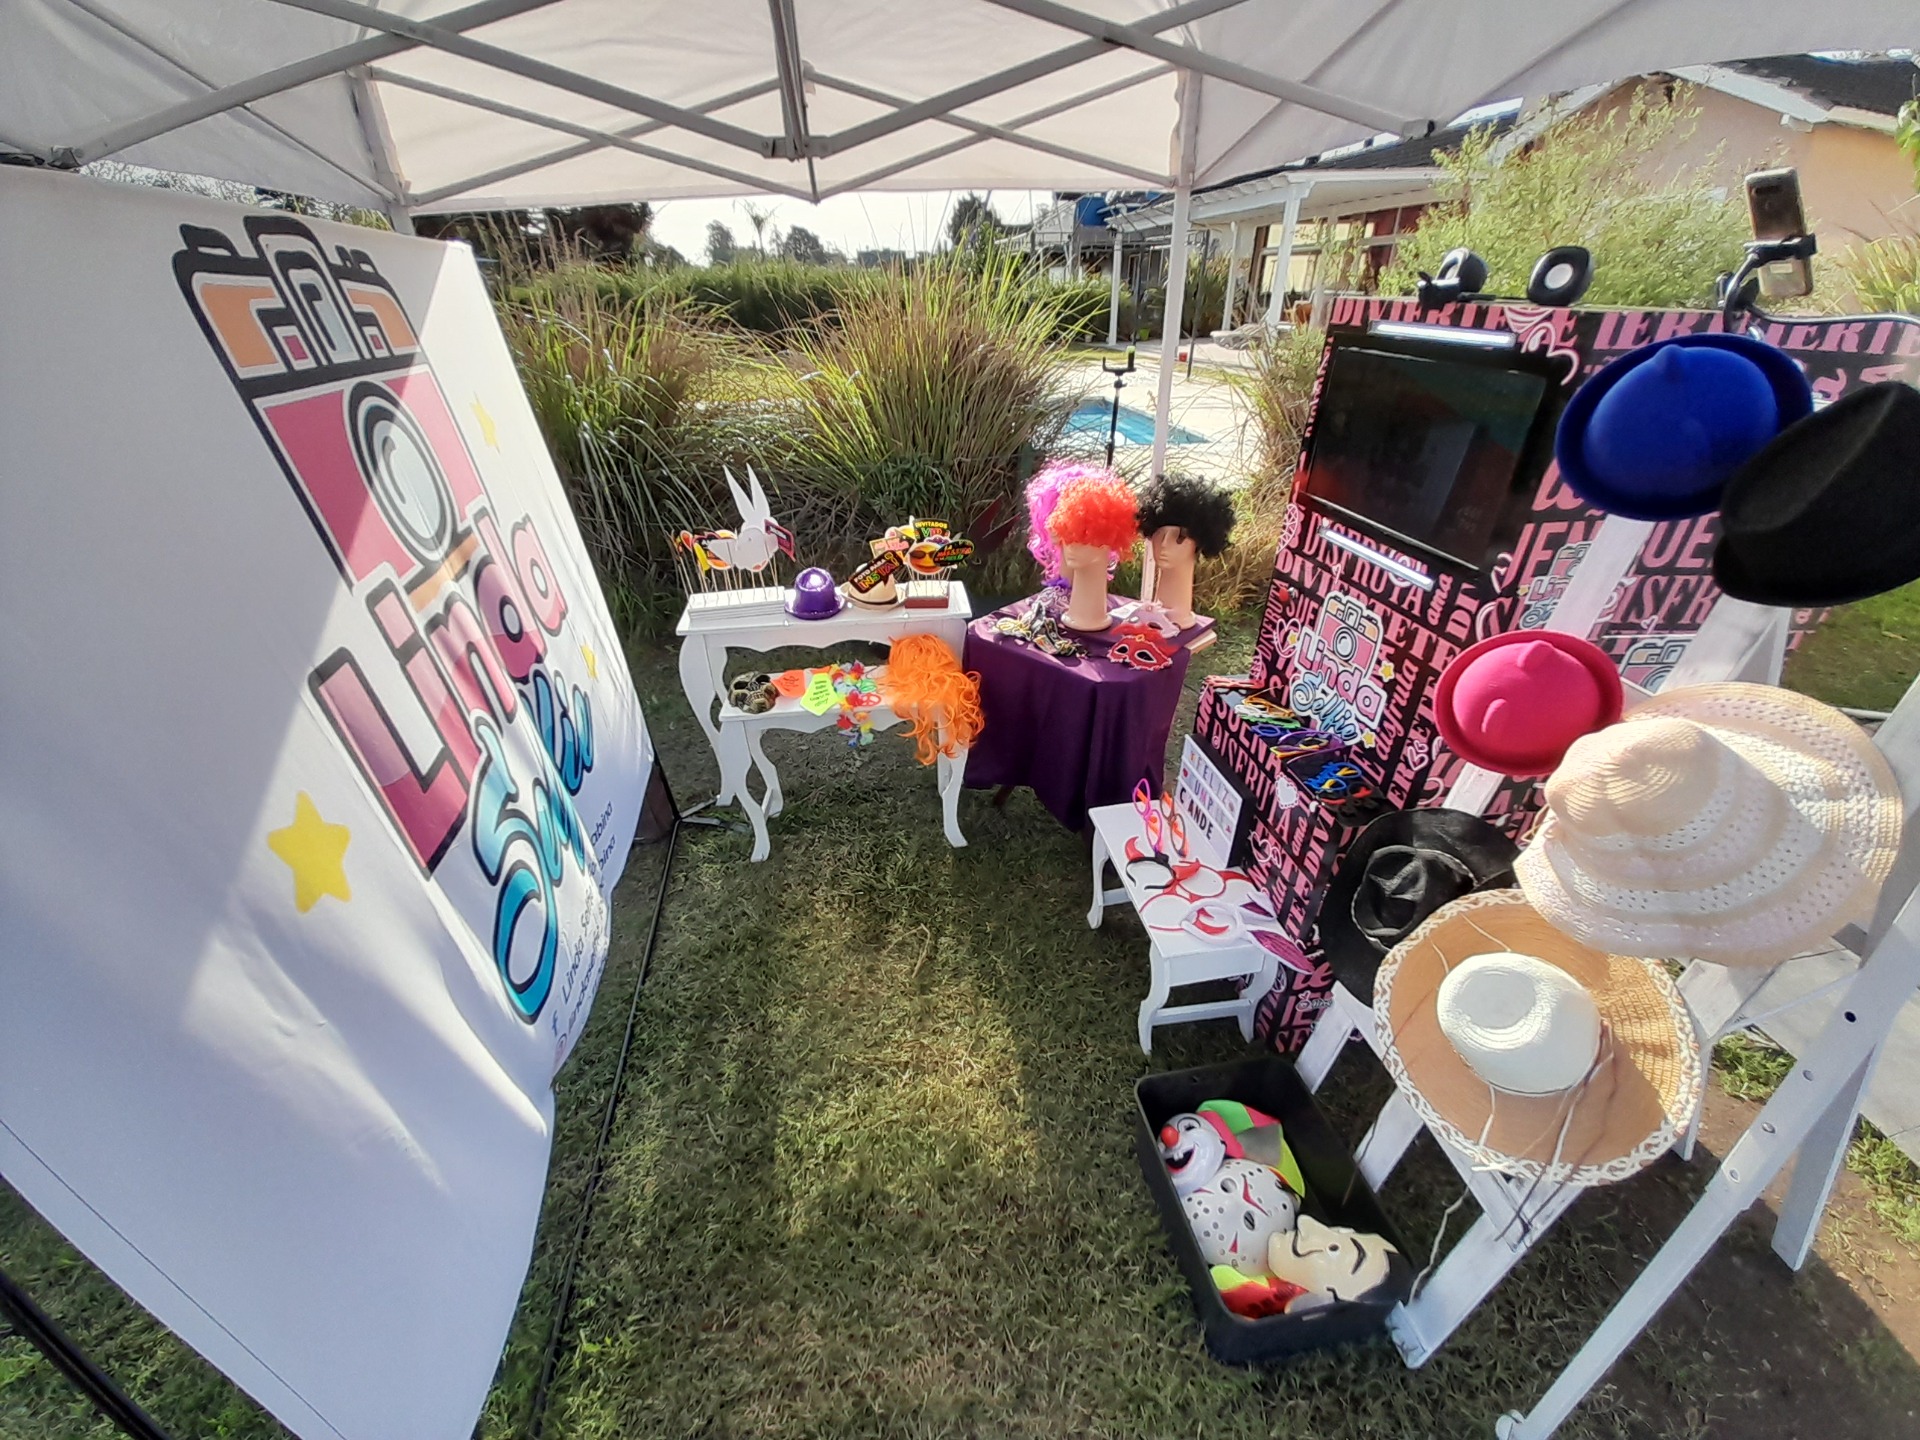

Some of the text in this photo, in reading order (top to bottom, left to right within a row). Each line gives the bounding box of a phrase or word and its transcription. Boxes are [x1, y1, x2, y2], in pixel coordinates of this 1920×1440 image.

[308, 505, 567, 880] Linda
[1293, 670, 1360, 742] Selfie
[1297, 632, 1382, 722] Linda
[1376, 658, 1419, 761] disfruta
[1179, 786, 1214, 841] CANDE
[1196, 755, 1229, 806] FELIZ
